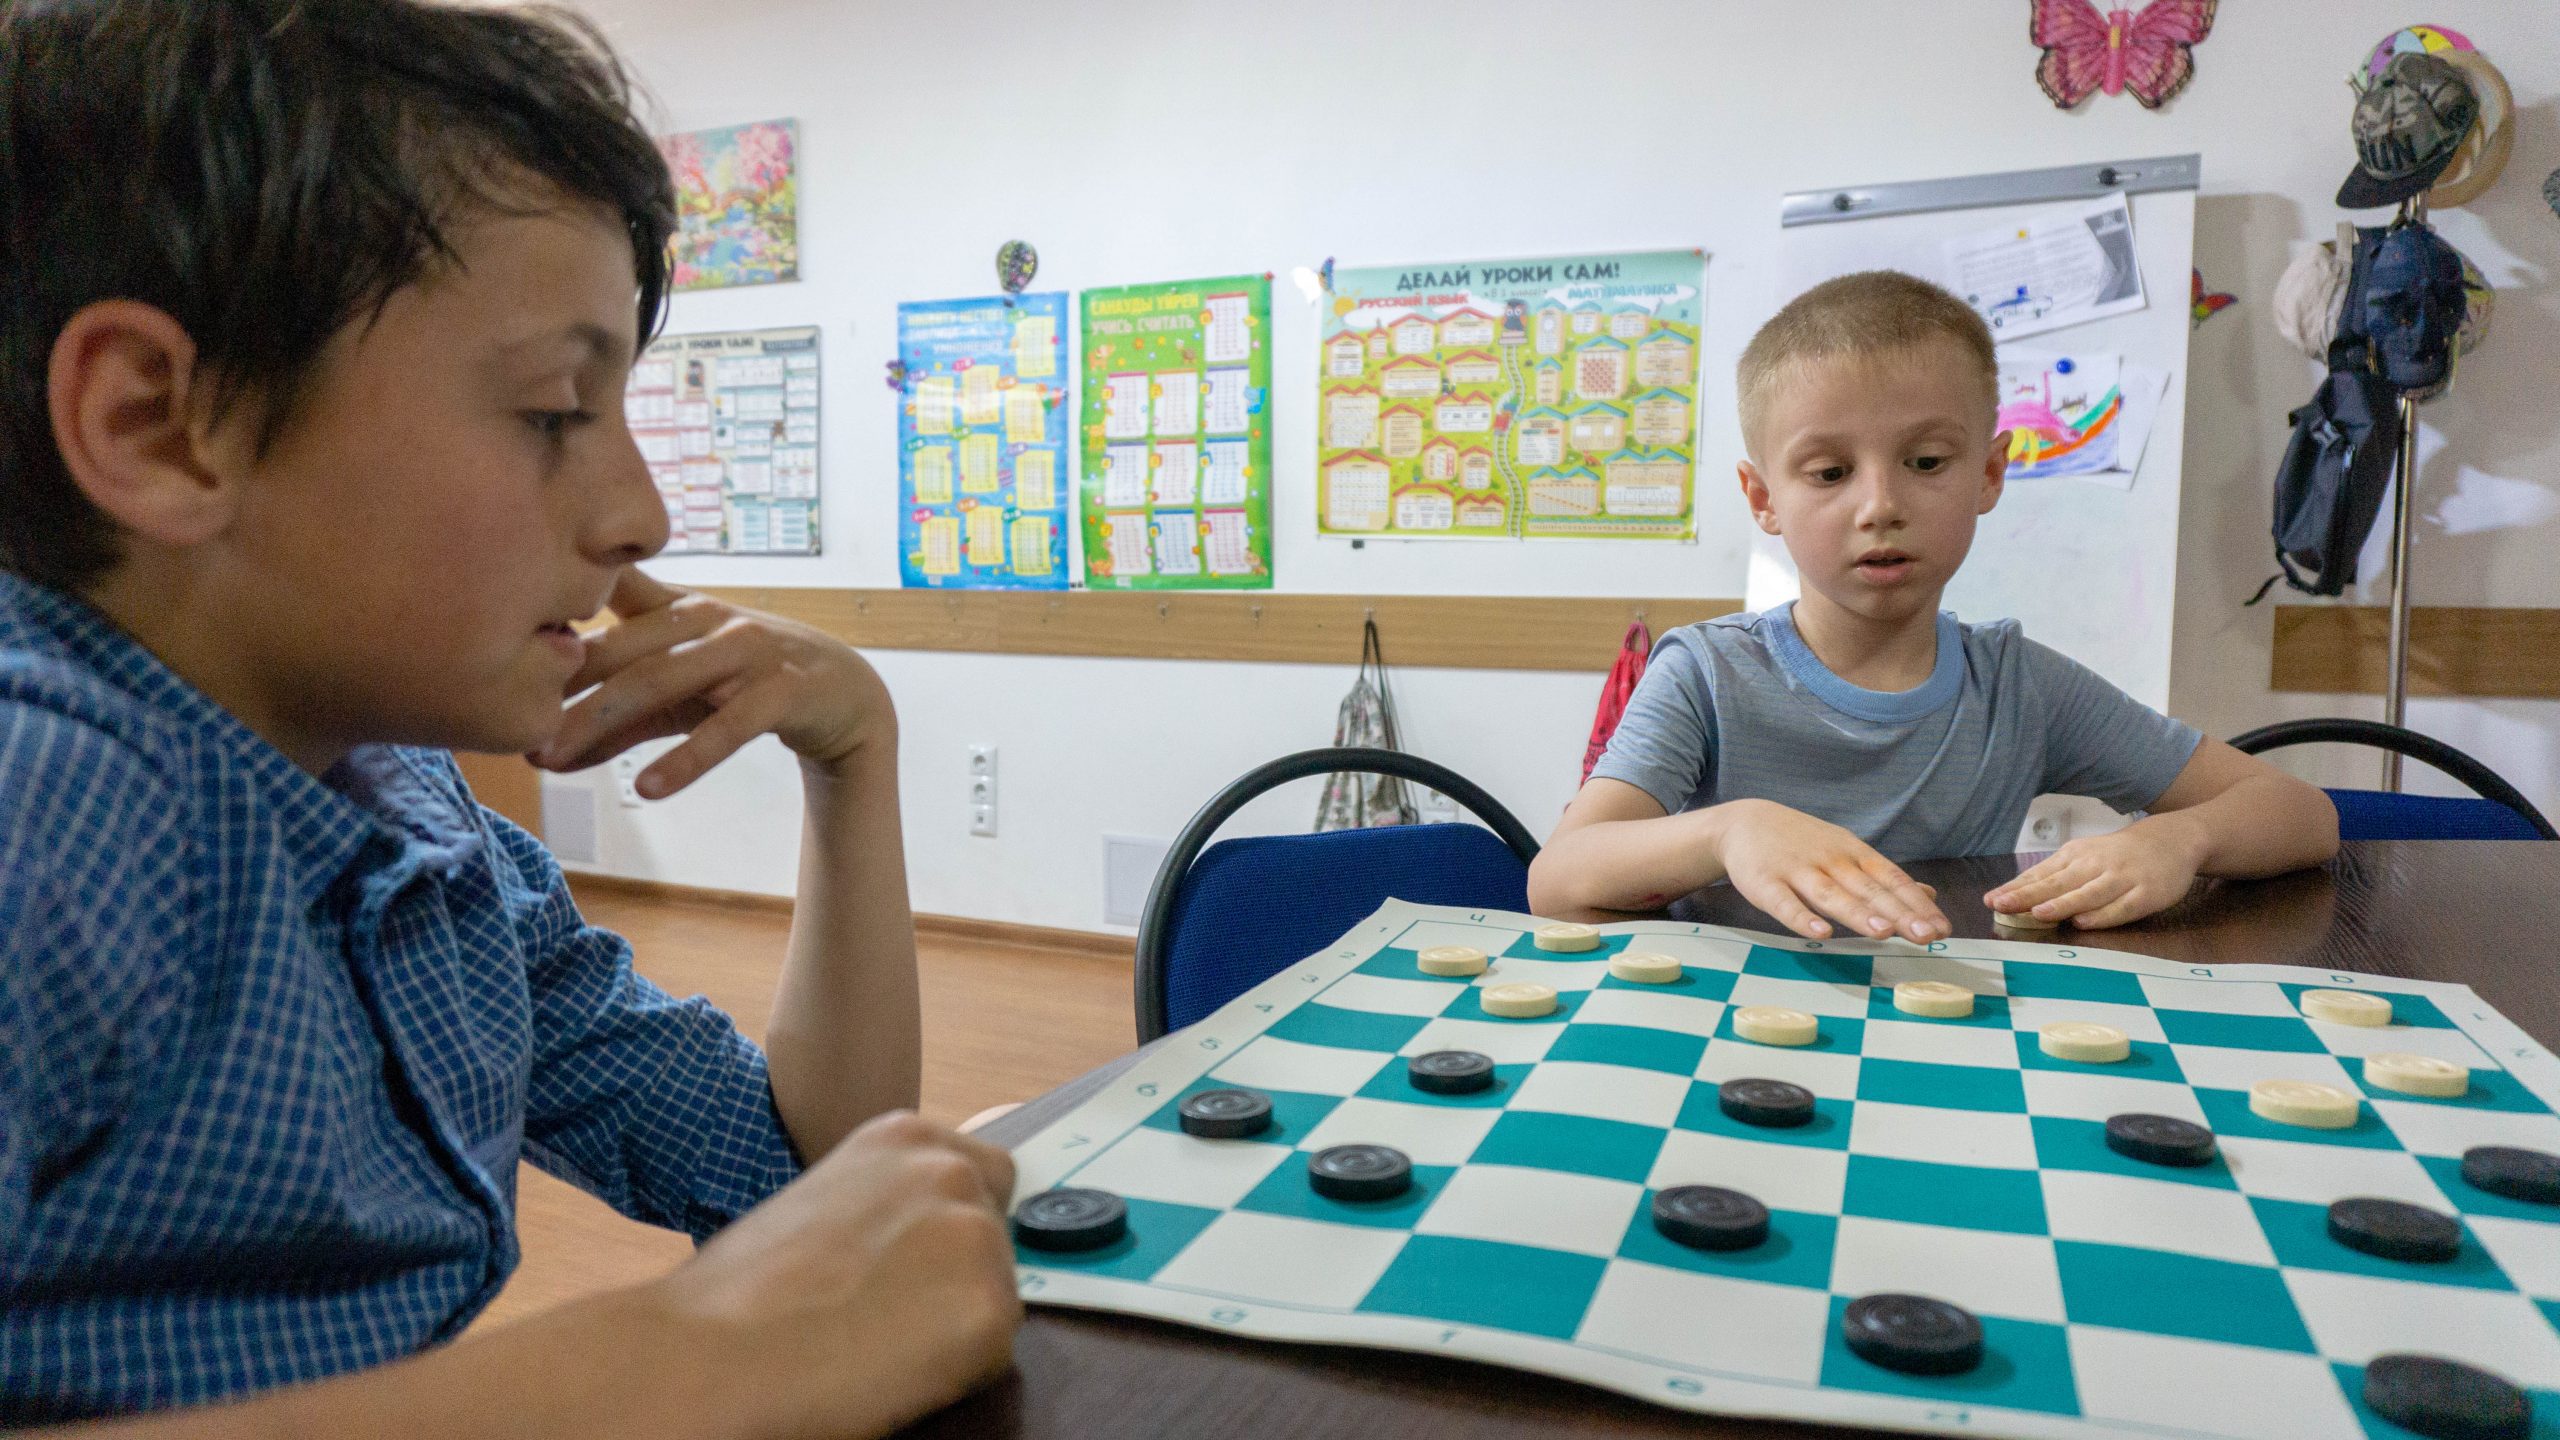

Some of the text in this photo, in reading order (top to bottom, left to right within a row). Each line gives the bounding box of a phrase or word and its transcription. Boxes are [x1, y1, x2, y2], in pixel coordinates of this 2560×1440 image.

[1397, 262, 1620, 291] ДЕЛАЙ УРОКИ САМ!
[1567, 283, 1678, 299] МАТЕМАТИКА
[1358, 292, 1468, 309] РУССКИЙ ЯЗЫК
[1091, 314, 1195, 336] УЧИСЬ СЧИТАТЬ
[1470, 913, 1486, 923] h
[1928, 942, 1947, 952] d
[1339, 951, 1356, 960] 2
[2057, 950, 2077, 959] c
[1301, 974, 1319, 983] 3
[2190, 968, 2213, 978] b
[2330, 975, 2354, 983] a
[1254, 1000, 1274, 1013] 4
[1200, 1037, 1222, 1050] 5
[1136, 1082, 1160, 1097] 6
[1063, 1133, 1090, 1149] 7
